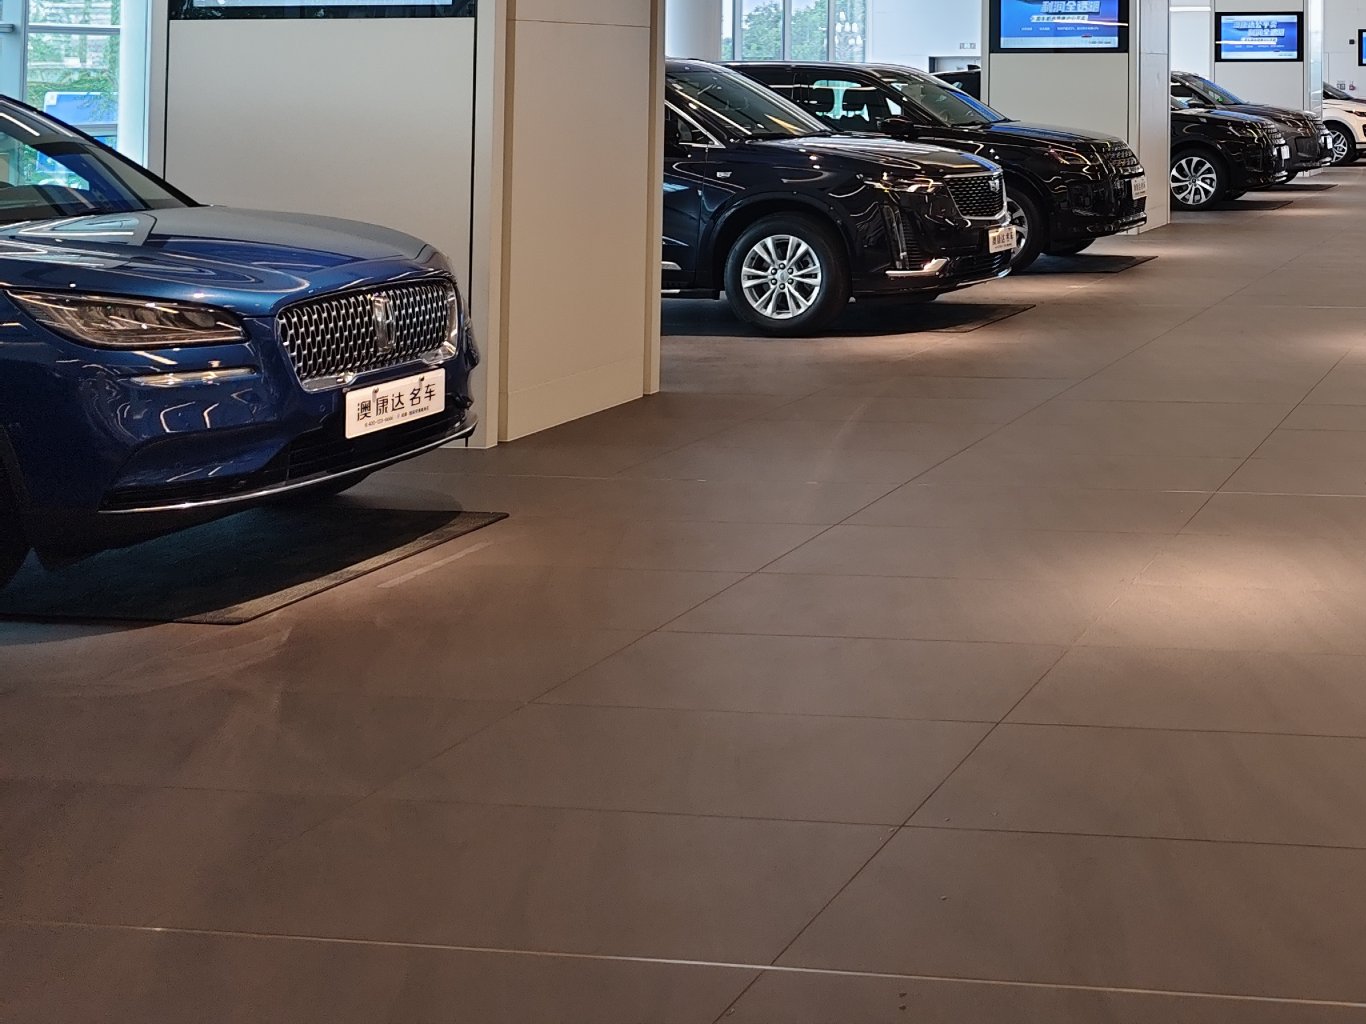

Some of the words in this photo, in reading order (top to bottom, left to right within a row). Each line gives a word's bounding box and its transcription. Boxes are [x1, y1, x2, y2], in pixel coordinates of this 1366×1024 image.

[357, 383, 436, 422] 澳康达名车
